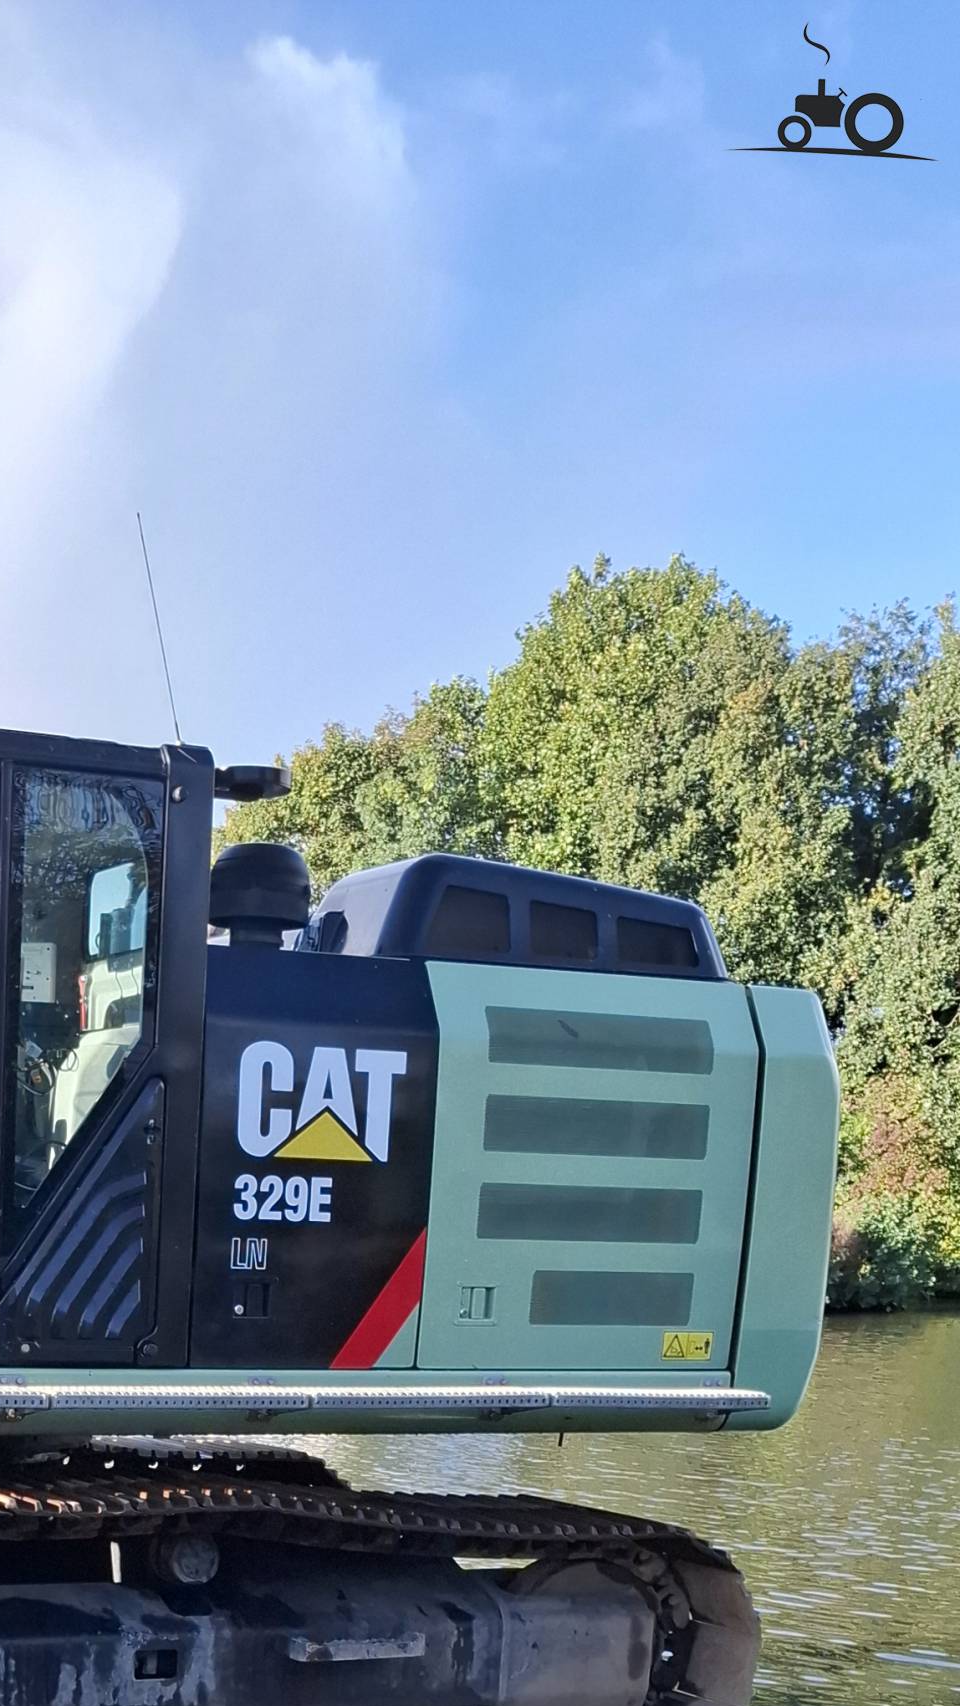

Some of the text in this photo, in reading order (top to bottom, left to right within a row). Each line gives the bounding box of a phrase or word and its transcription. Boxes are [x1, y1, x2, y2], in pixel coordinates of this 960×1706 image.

[237, 1040, 408, 1163] CAT
[233, 1173, 333, 1223] 329E
[230, 1237, 268, 1270] LN
